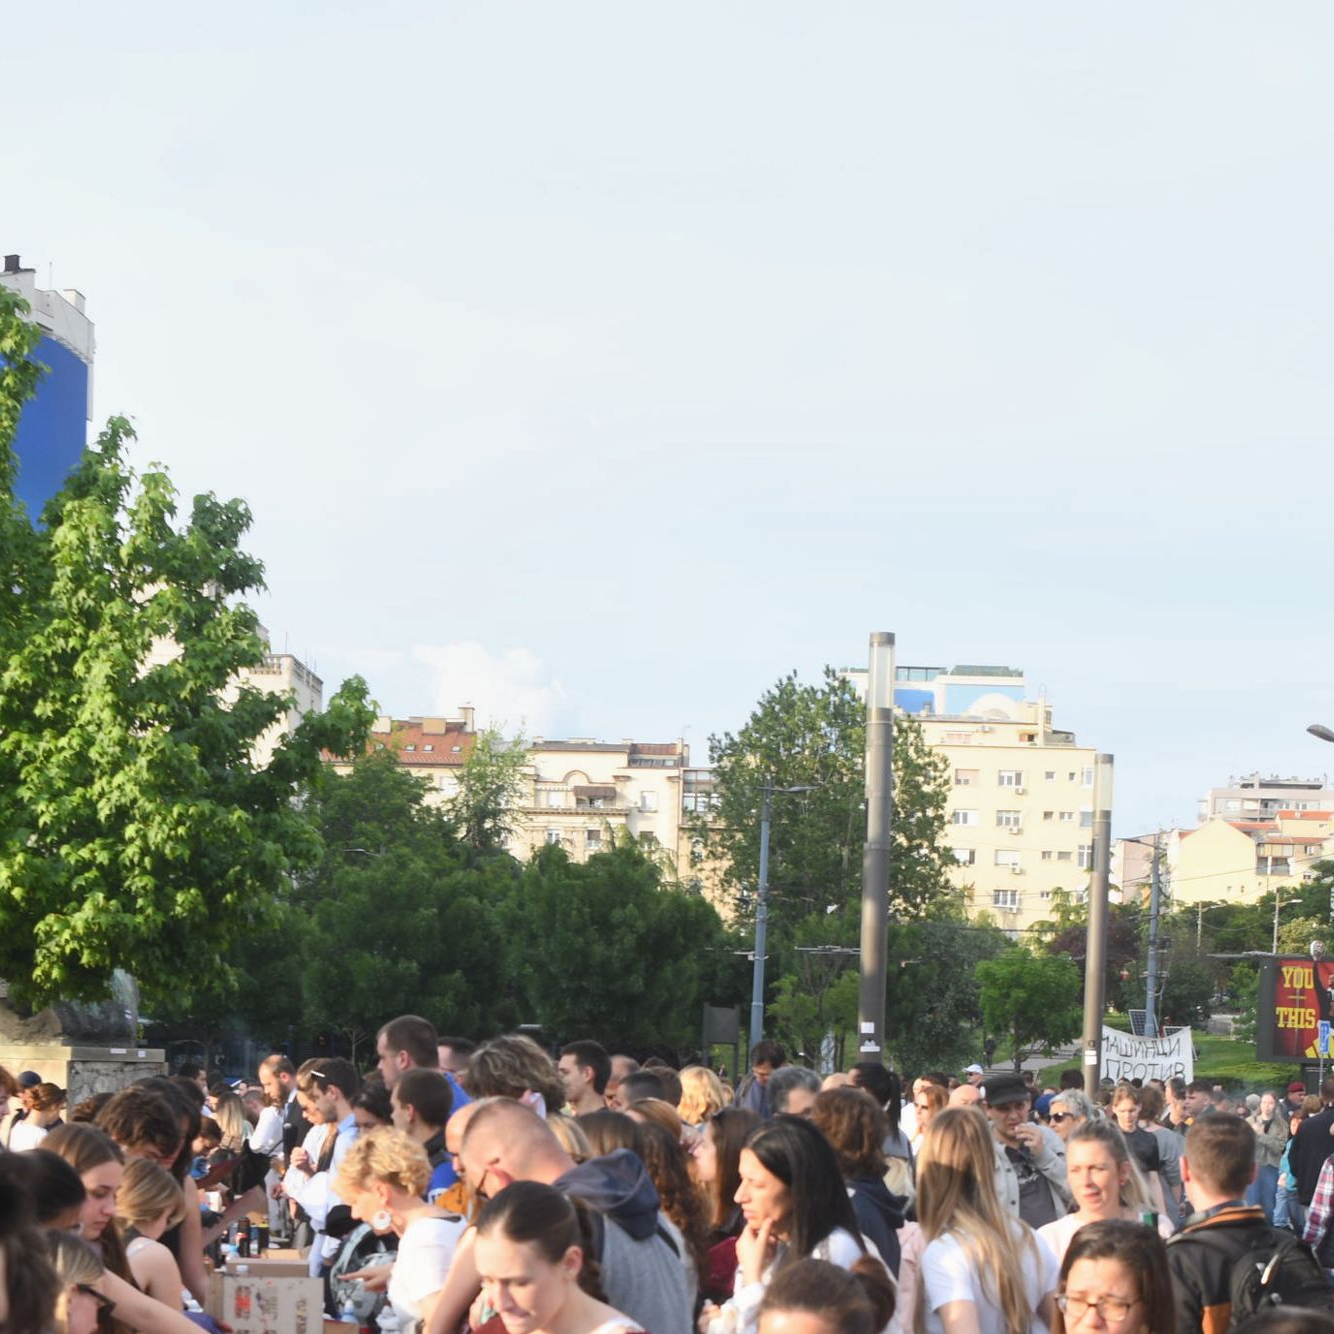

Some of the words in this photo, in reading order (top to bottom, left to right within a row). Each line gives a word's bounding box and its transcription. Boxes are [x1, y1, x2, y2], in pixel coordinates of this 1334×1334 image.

[1282, 966, 1315, 990] YOU
[1276, 1007, 1316, 1029] THIS
[1106, 1058, 1186, 1080] ПРОТИВ
